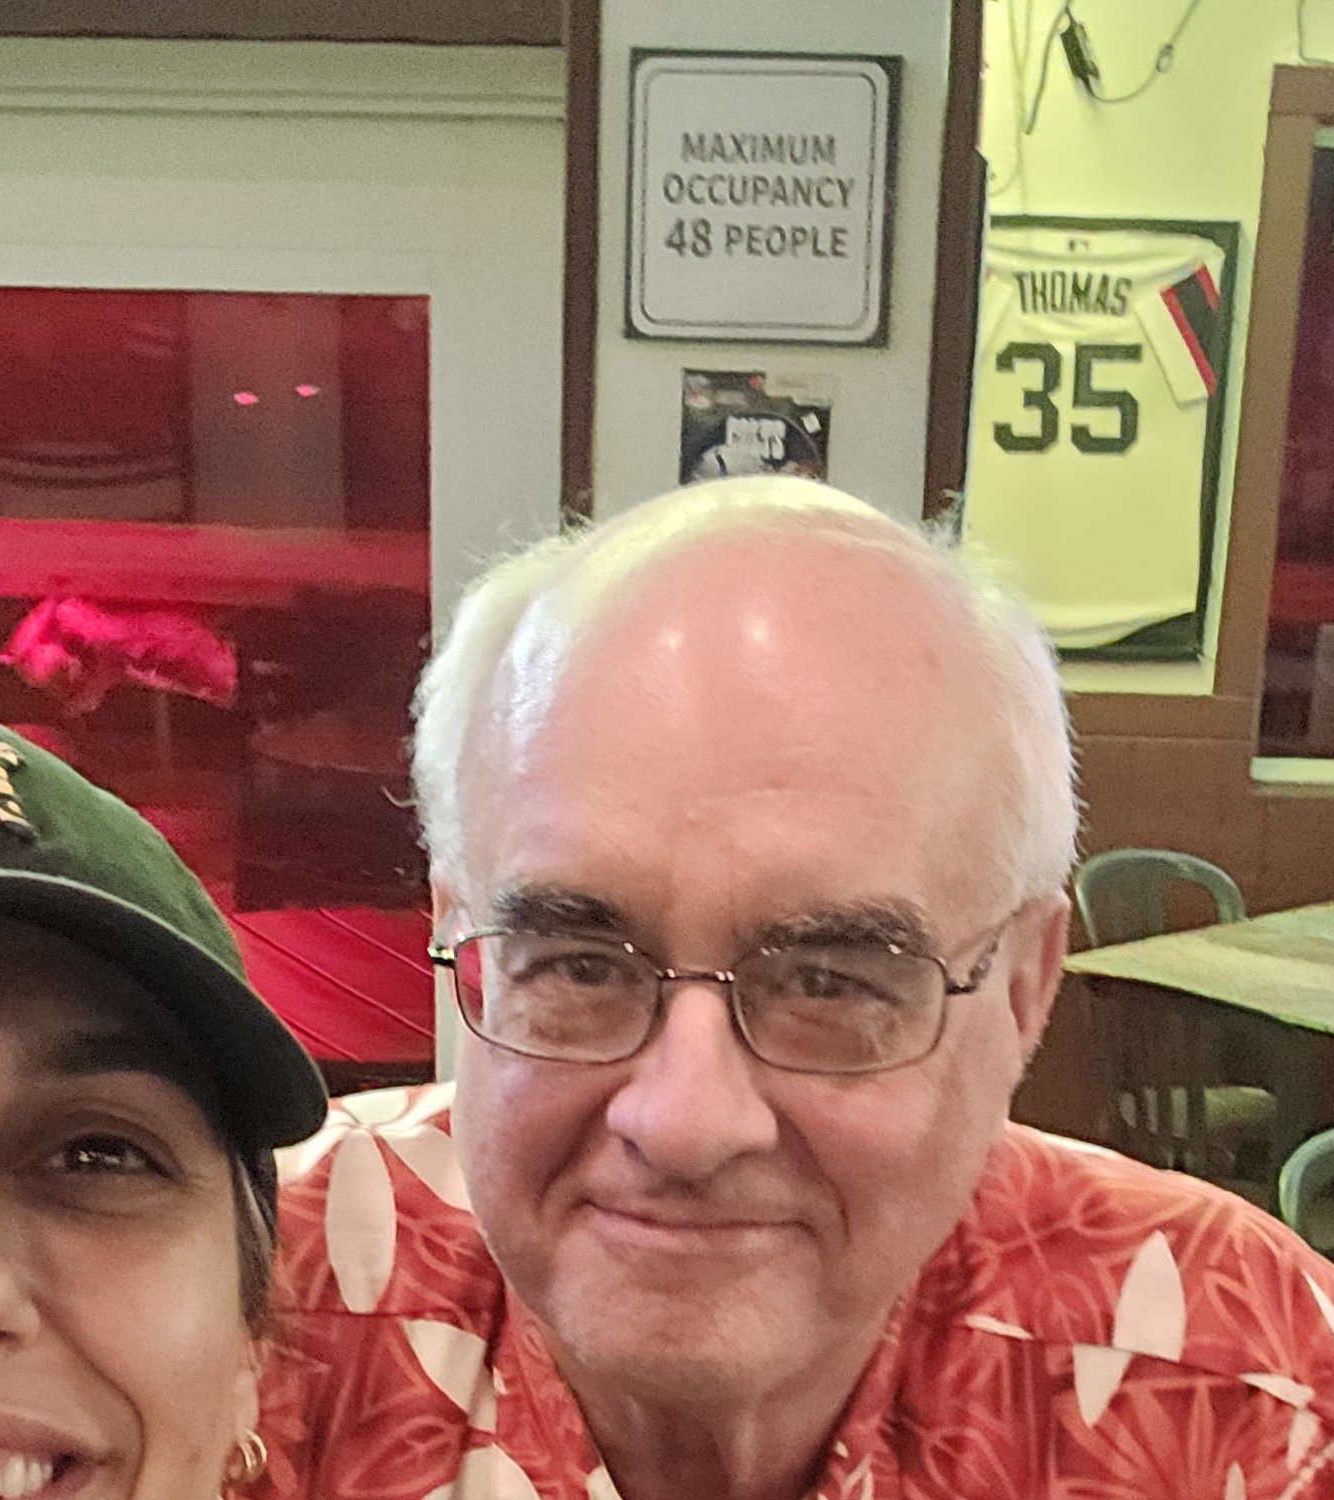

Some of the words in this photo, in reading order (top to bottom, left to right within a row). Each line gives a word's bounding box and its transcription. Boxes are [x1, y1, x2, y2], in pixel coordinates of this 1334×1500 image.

[680, 132, 836, 166] MAXIMUM
[662, 172, 855, 208] OCCUPANCY
[665, 217, 712, 258] 48
[724, 223, 848, 258] PEOPLE
[1013, 270, 1133, 317] THOMAS
[993, 340, 1143, 456] 35
